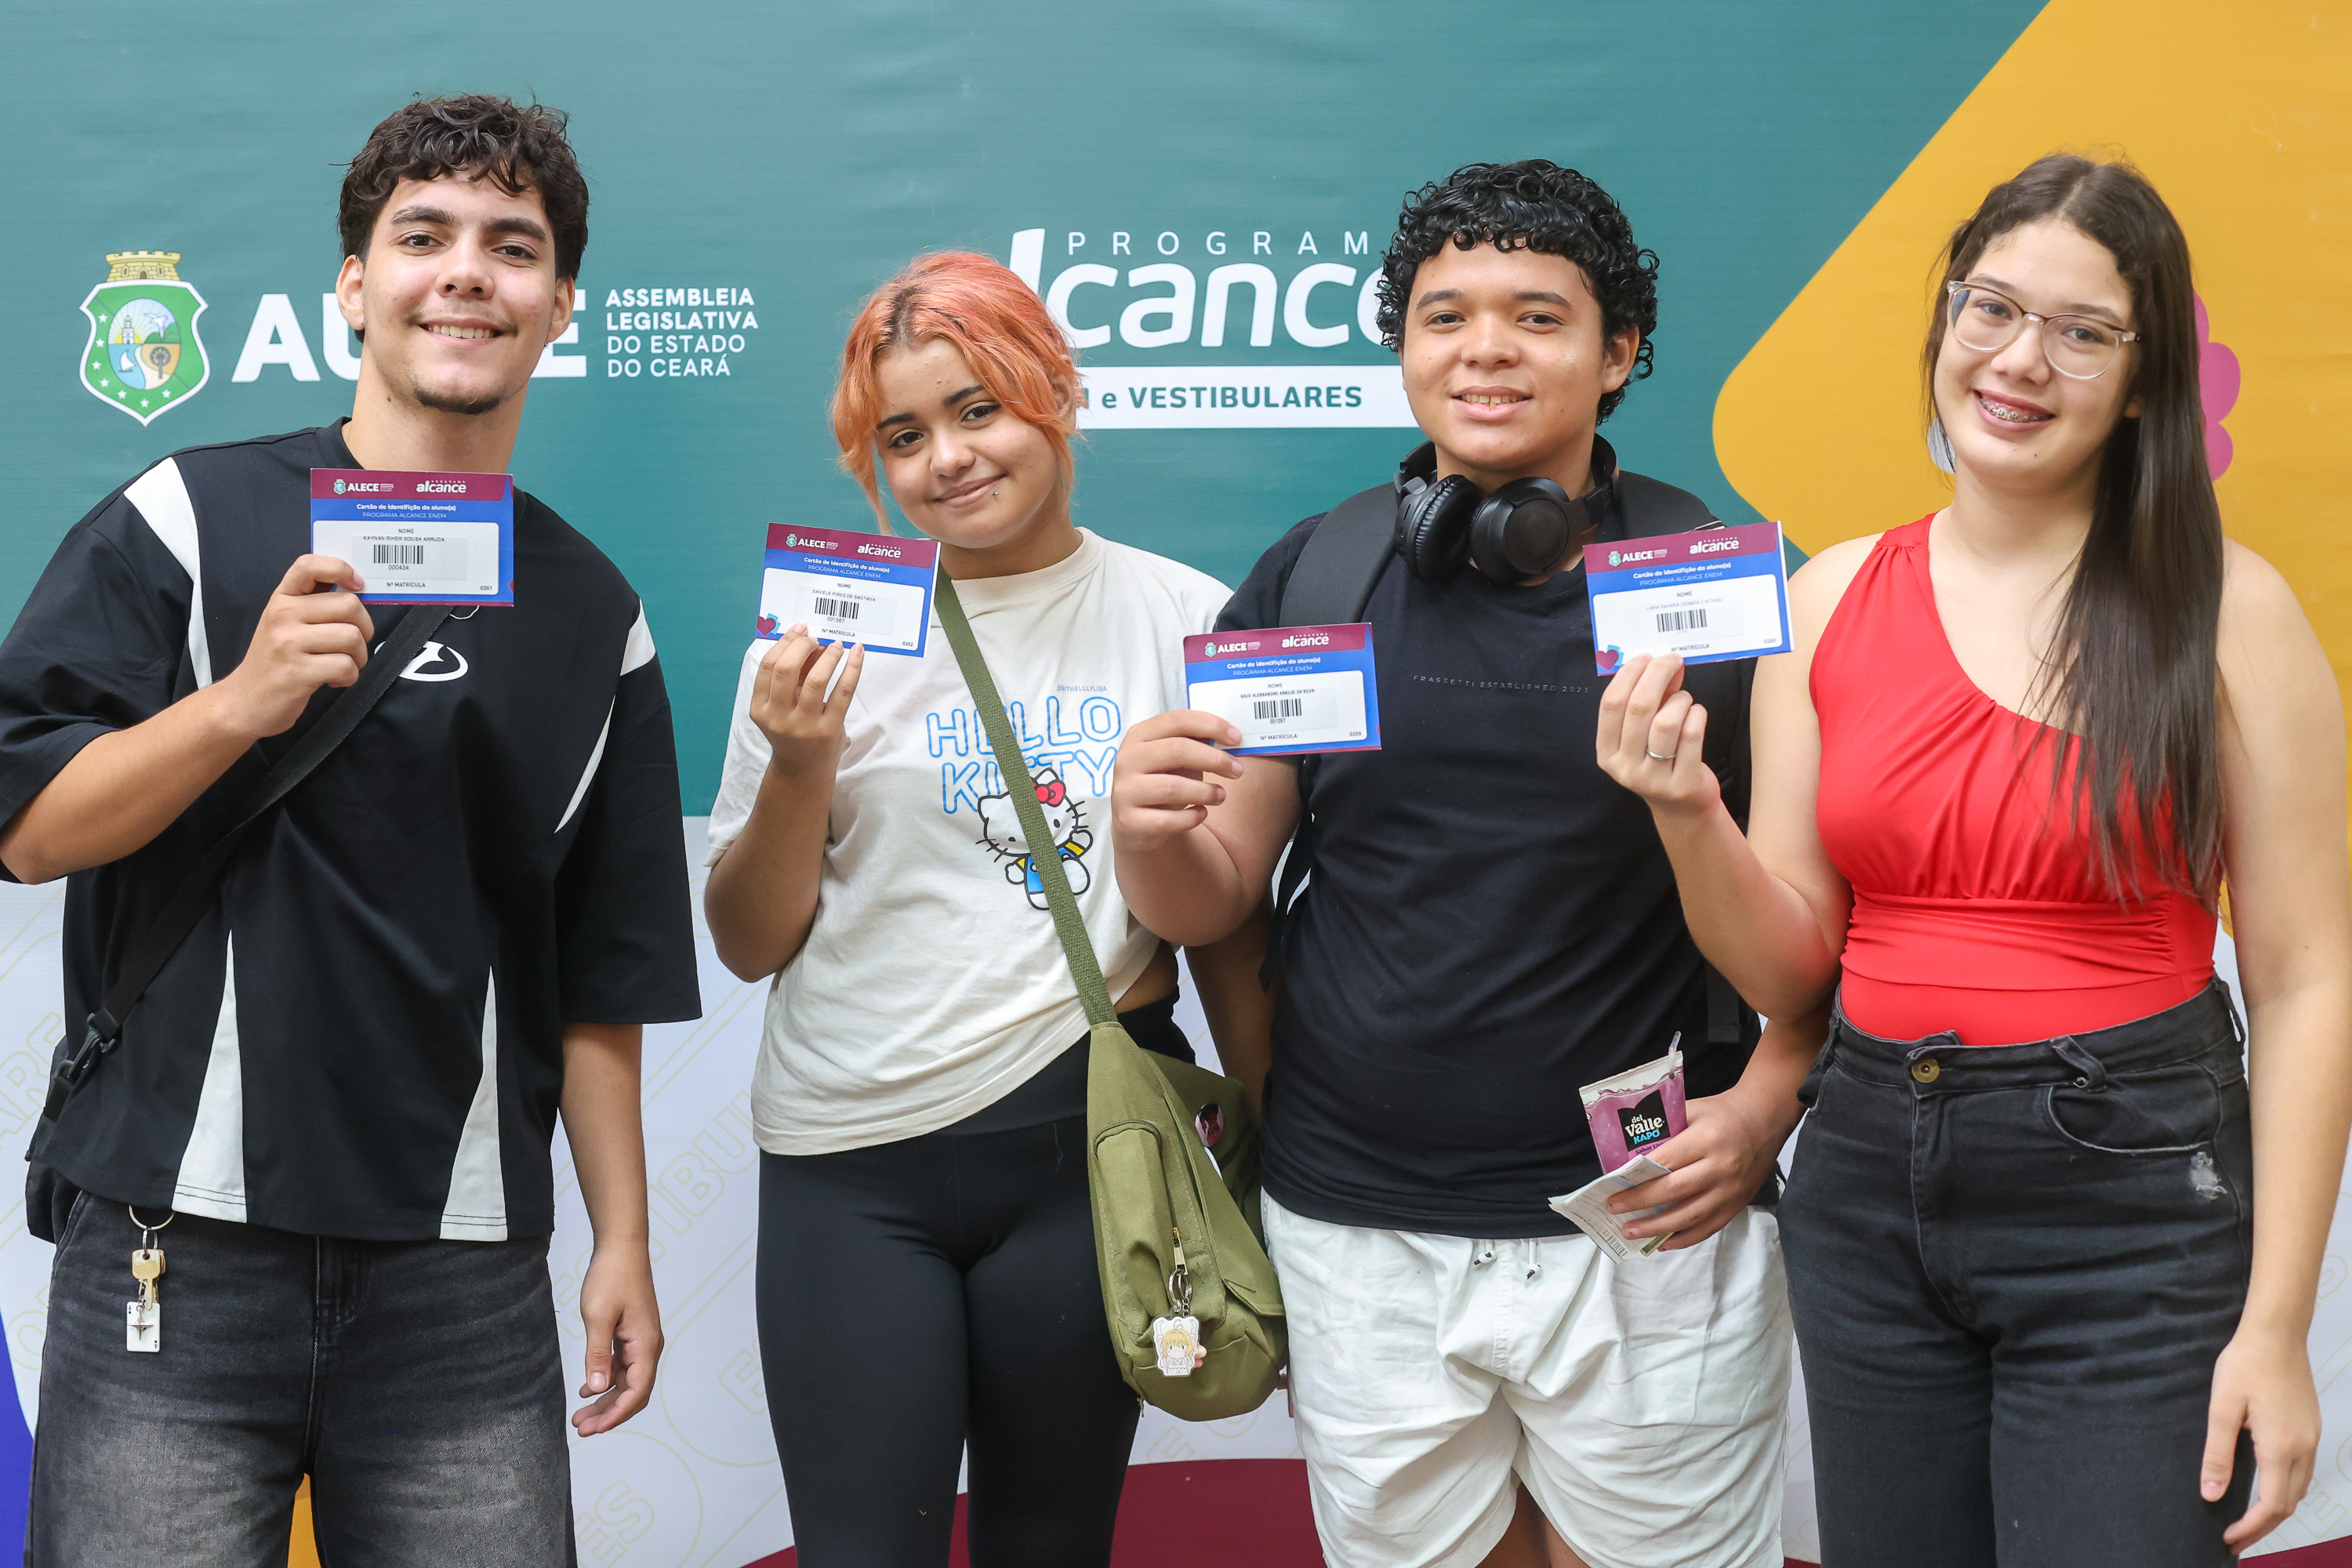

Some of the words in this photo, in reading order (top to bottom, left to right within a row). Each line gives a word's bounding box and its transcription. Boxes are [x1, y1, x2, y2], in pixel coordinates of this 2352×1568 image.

[1068, 230, 1369, 256] PROGRAM
[1009, 227, 1389, 349] lcanc
[606, 288, 754, 307] ASSEMBLEIA
[606, 311, 759, 331] LEGISLATIVA
[607, 336, 642, 354] DO
[649, 335, 746, 354] ESTADO
[607, 360, 643, 377] DO
[650, 353, 731, 377] CEARÁ
[1102, 390, 1117, 408] e
[1127, 387, 1362, 408] VESTIBULARES
[347, 483, 379, 492] ALECE
[416, 481, 466, 493] alcance
[798, 538, 826, 549] ALECE
[1690, 539, 1740, 554] alcance
[858, 544, 902, 558] alcance
[1622, 550, 1653, 563] ALECE
[808, 564, 839, 573] PROGRAMA
[831, 560, 859, 569] identifição
[1640, 577, 1675, 586] PROGRAMA
[1281, 635, 1330, 648] alcance
[1217, 643, 1247, 654] ALECE
[1414, 675, 1475, 688] FRASSETTI
[1480, 681, 1556, 691] ESTABLISHED
[942, 746, 1118, 814] KITY
[1632, 1114, 1643, 1123] del
[1635, 1145, 1653, 1154] Sabor
